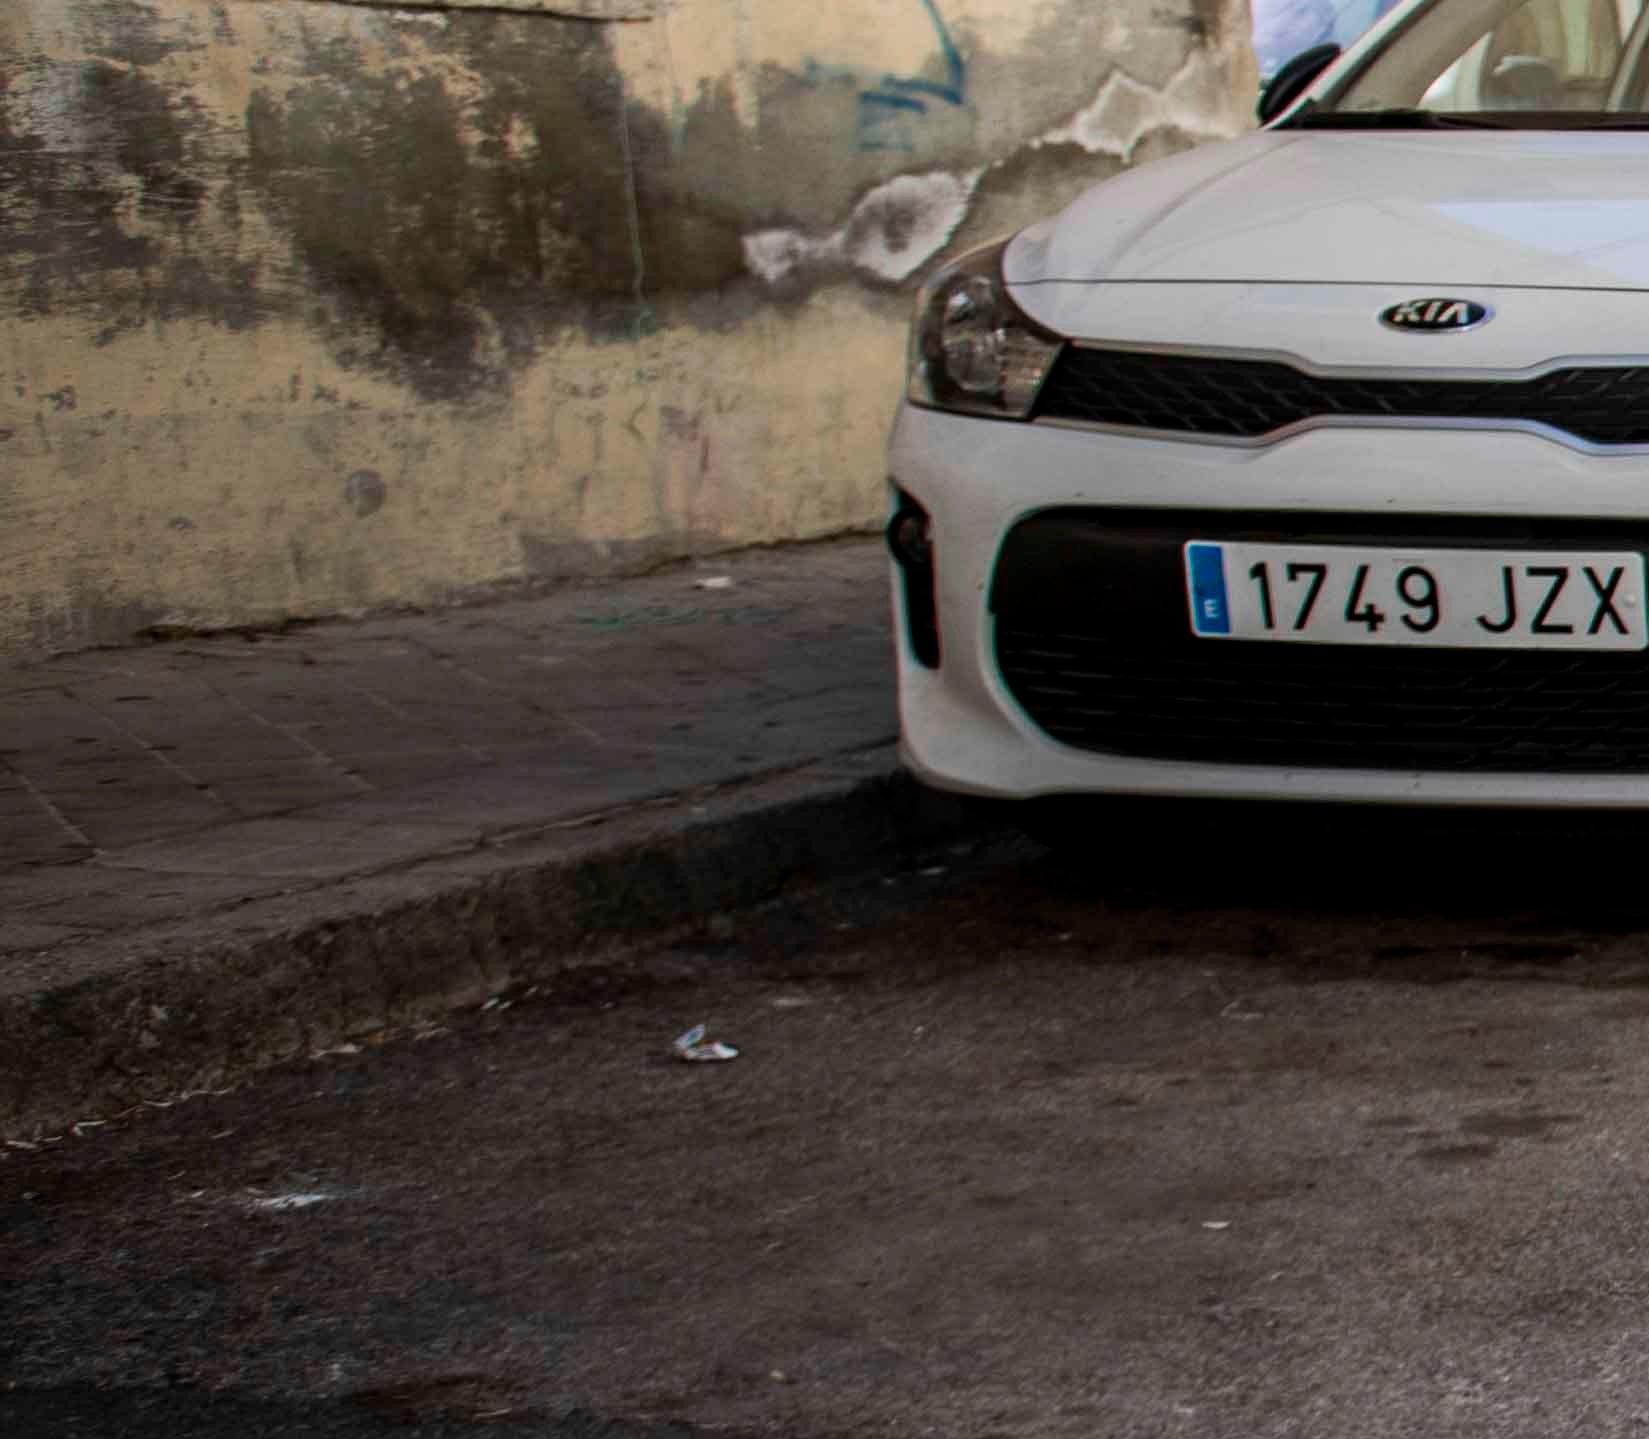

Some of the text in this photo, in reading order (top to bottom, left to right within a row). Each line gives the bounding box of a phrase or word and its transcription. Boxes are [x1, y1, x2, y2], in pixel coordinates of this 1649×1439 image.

[1392, 300, 1468, 323] KIA
[1249, 561, 1441, 634] 1749
[1476, 565, 1629, 636] JZX
